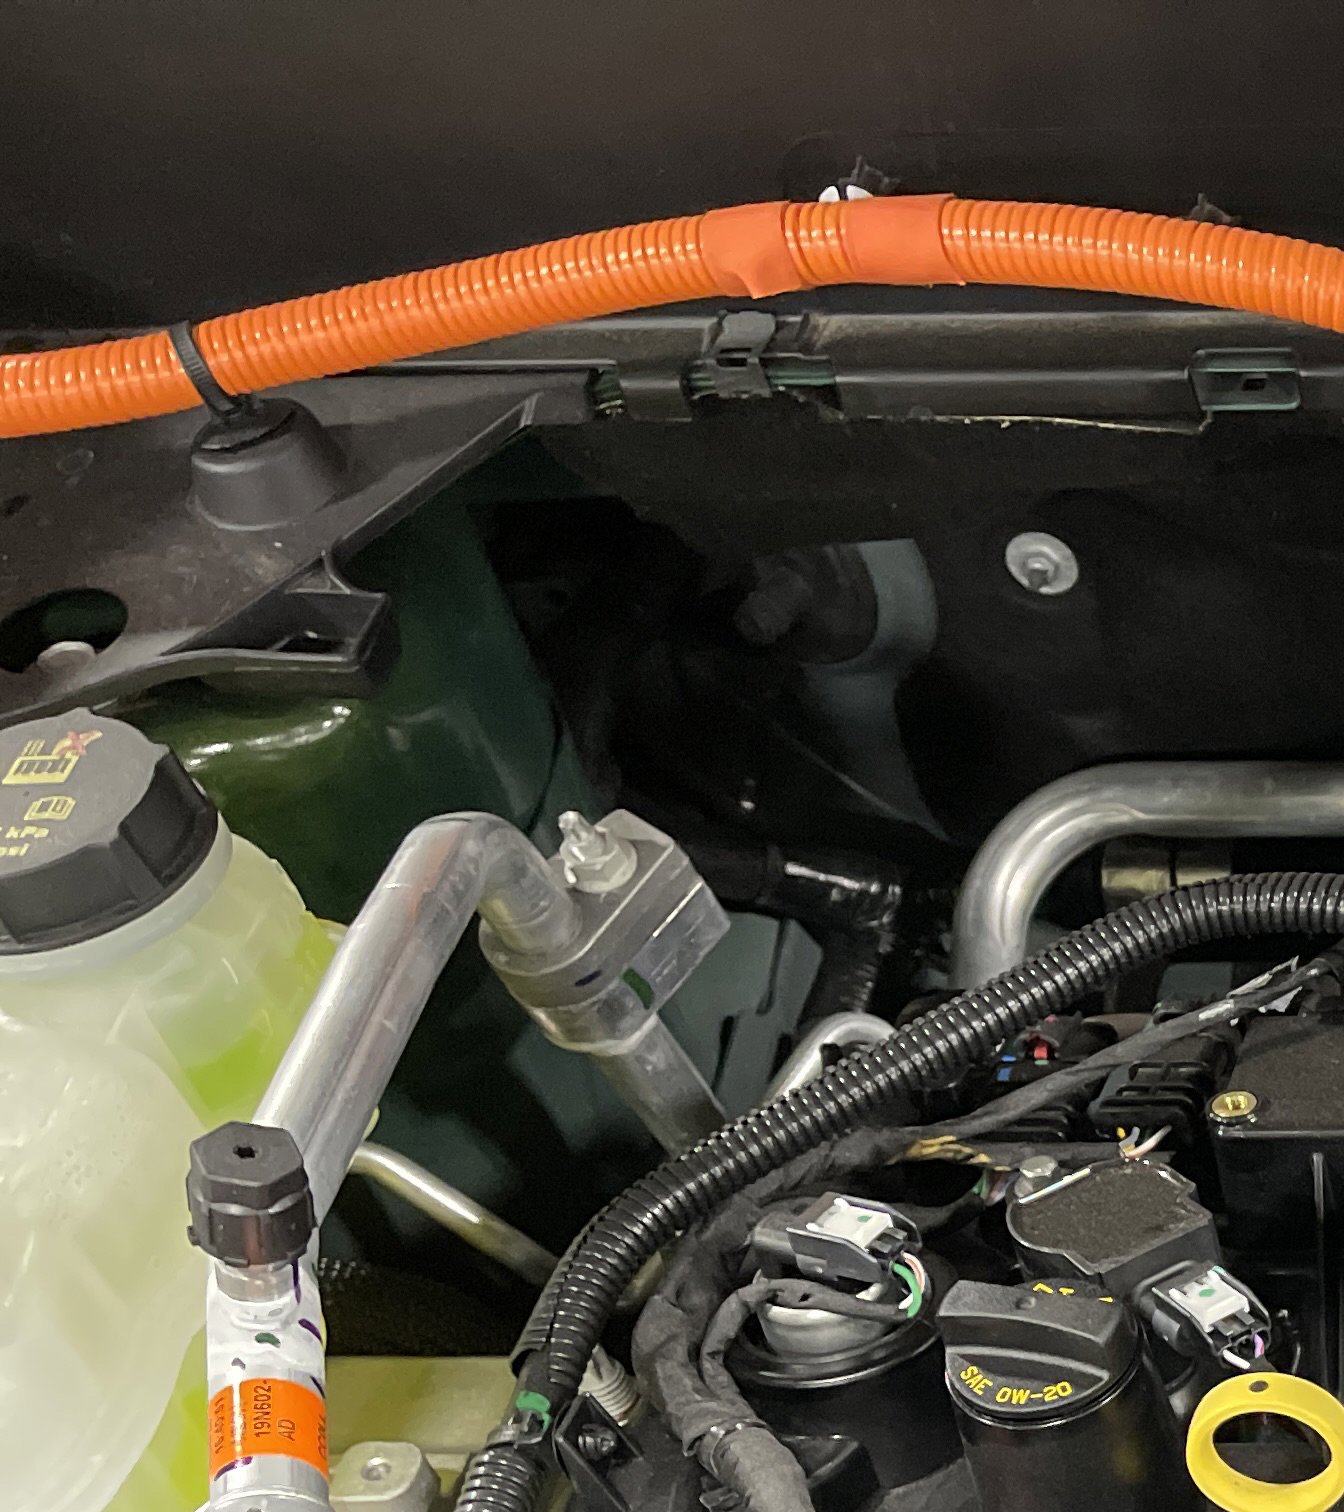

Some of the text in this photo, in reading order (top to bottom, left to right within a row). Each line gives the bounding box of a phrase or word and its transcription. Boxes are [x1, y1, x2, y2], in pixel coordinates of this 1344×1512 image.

[960, 1365, 1073, 1405] SAE 0W-20
[277, 1419, 296, 1441] AD
